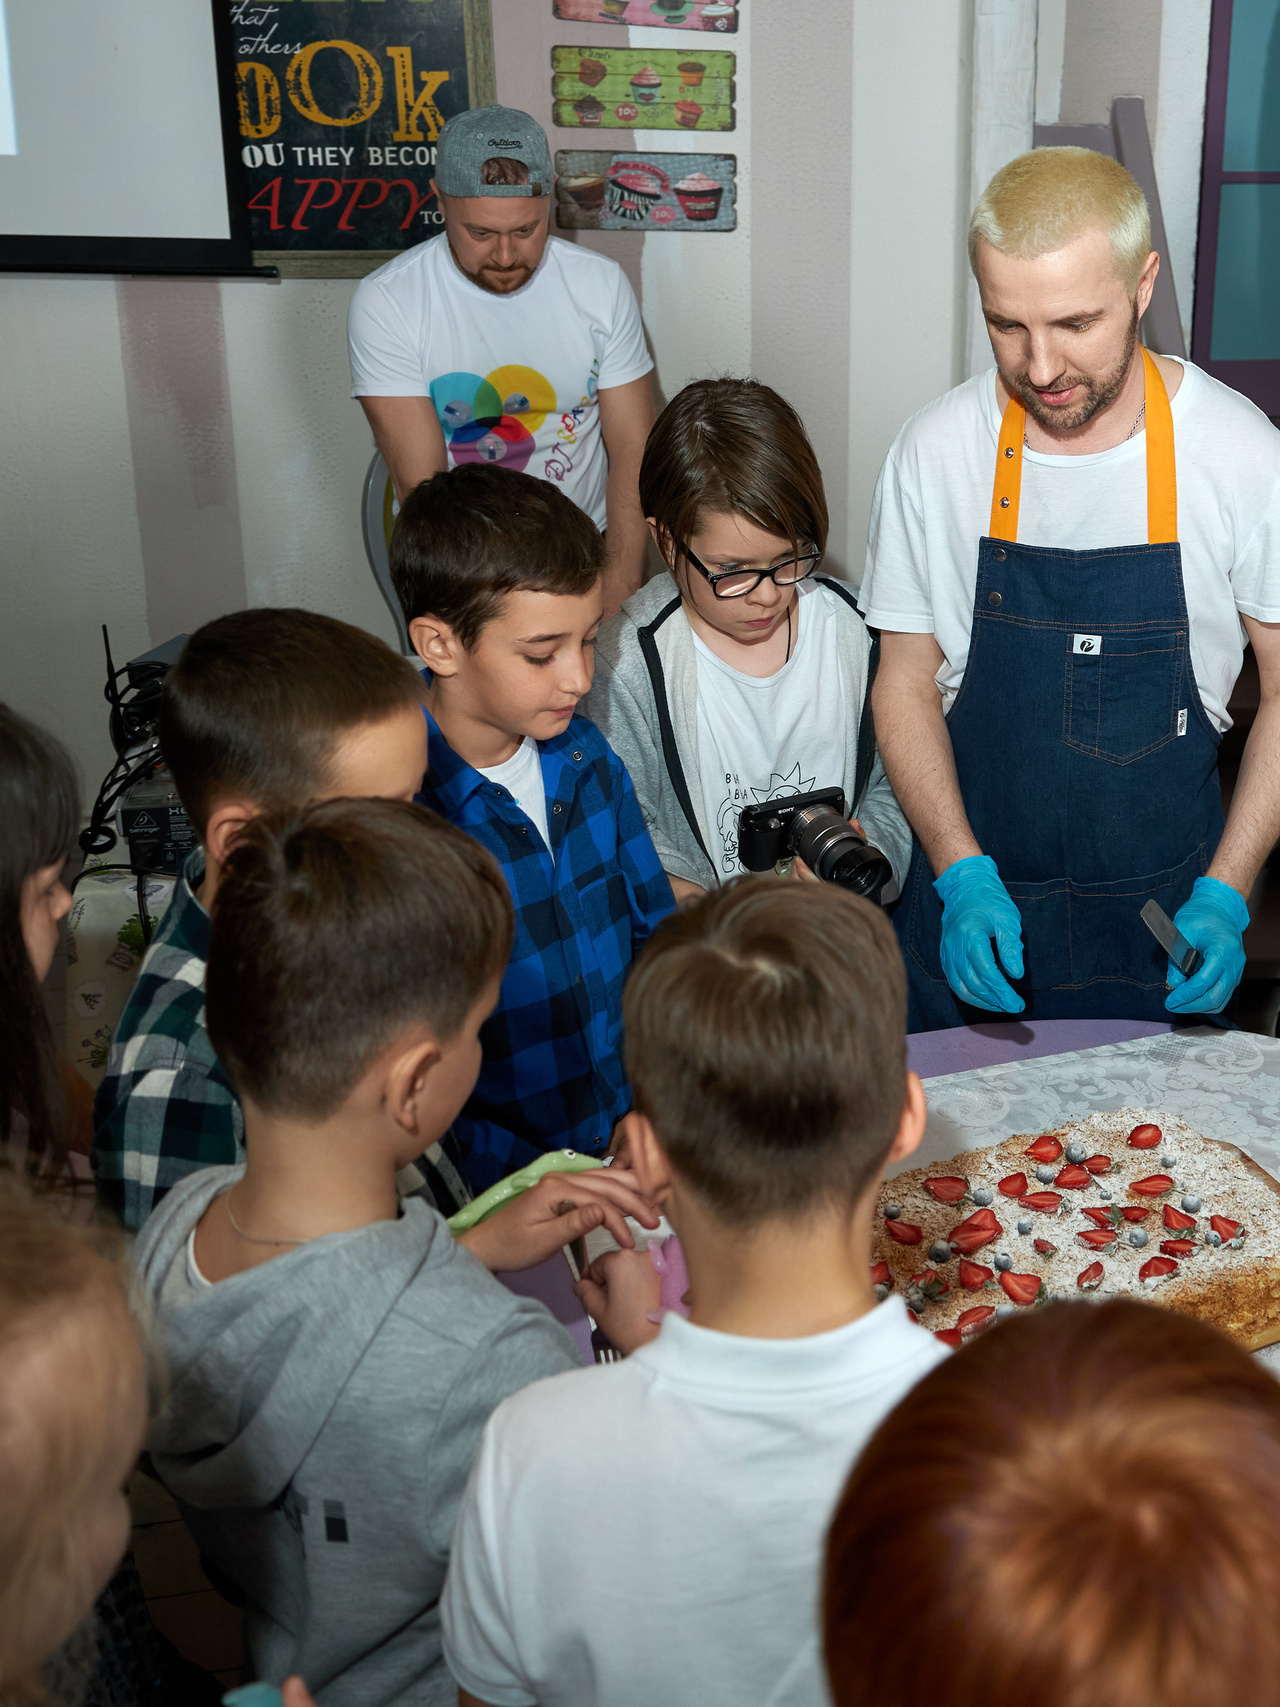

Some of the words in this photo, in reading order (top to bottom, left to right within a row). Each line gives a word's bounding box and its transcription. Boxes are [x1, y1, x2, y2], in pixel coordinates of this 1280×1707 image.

[238, 22, 303, 54] others
[292, 147, 354, 166] THEY
[778, 807, 795, 815] SONY
